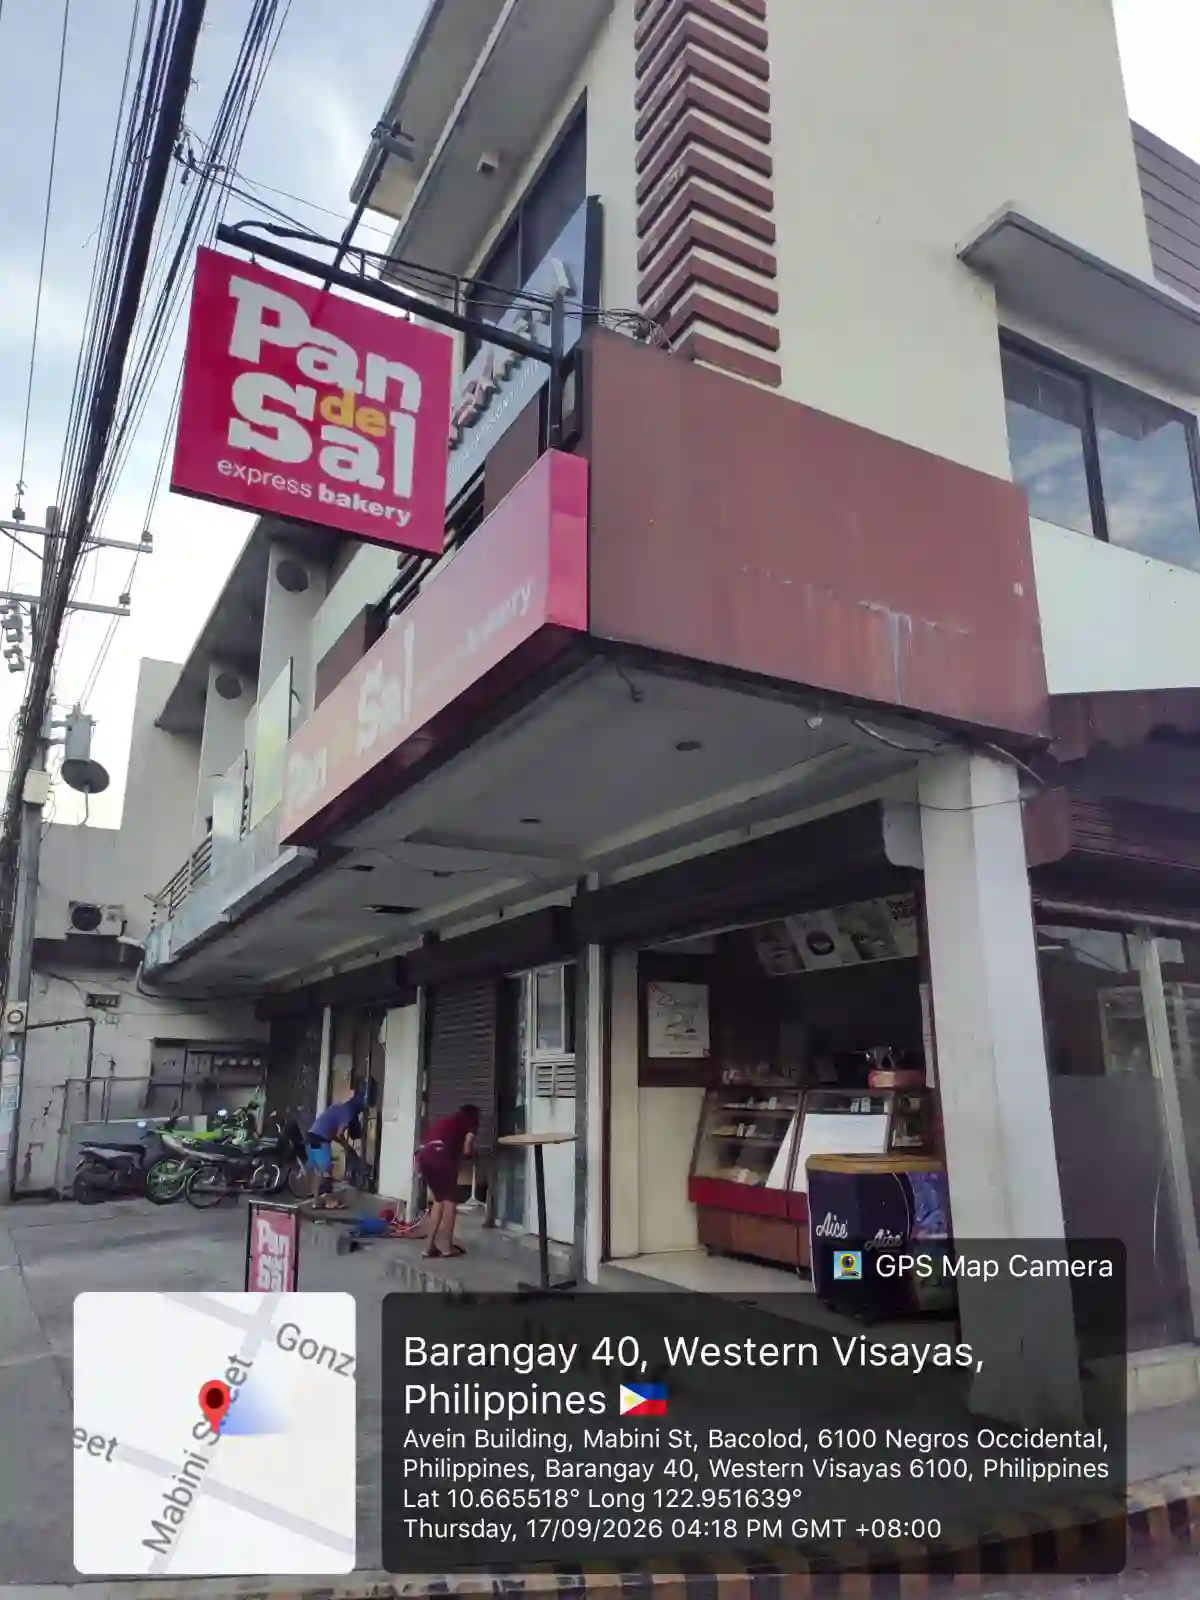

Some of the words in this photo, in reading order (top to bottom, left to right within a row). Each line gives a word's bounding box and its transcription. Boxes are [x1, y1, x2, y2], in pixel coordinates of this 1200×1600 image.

[228, 275, 422, 413] Pan
[227, 371, 416, 499] Sal
[320, 391, 387, 437] de
[217, 459, 313, 498] express
[317, 483, 411, 527] bakery
[815, 1211, 848, 1239] Aice
